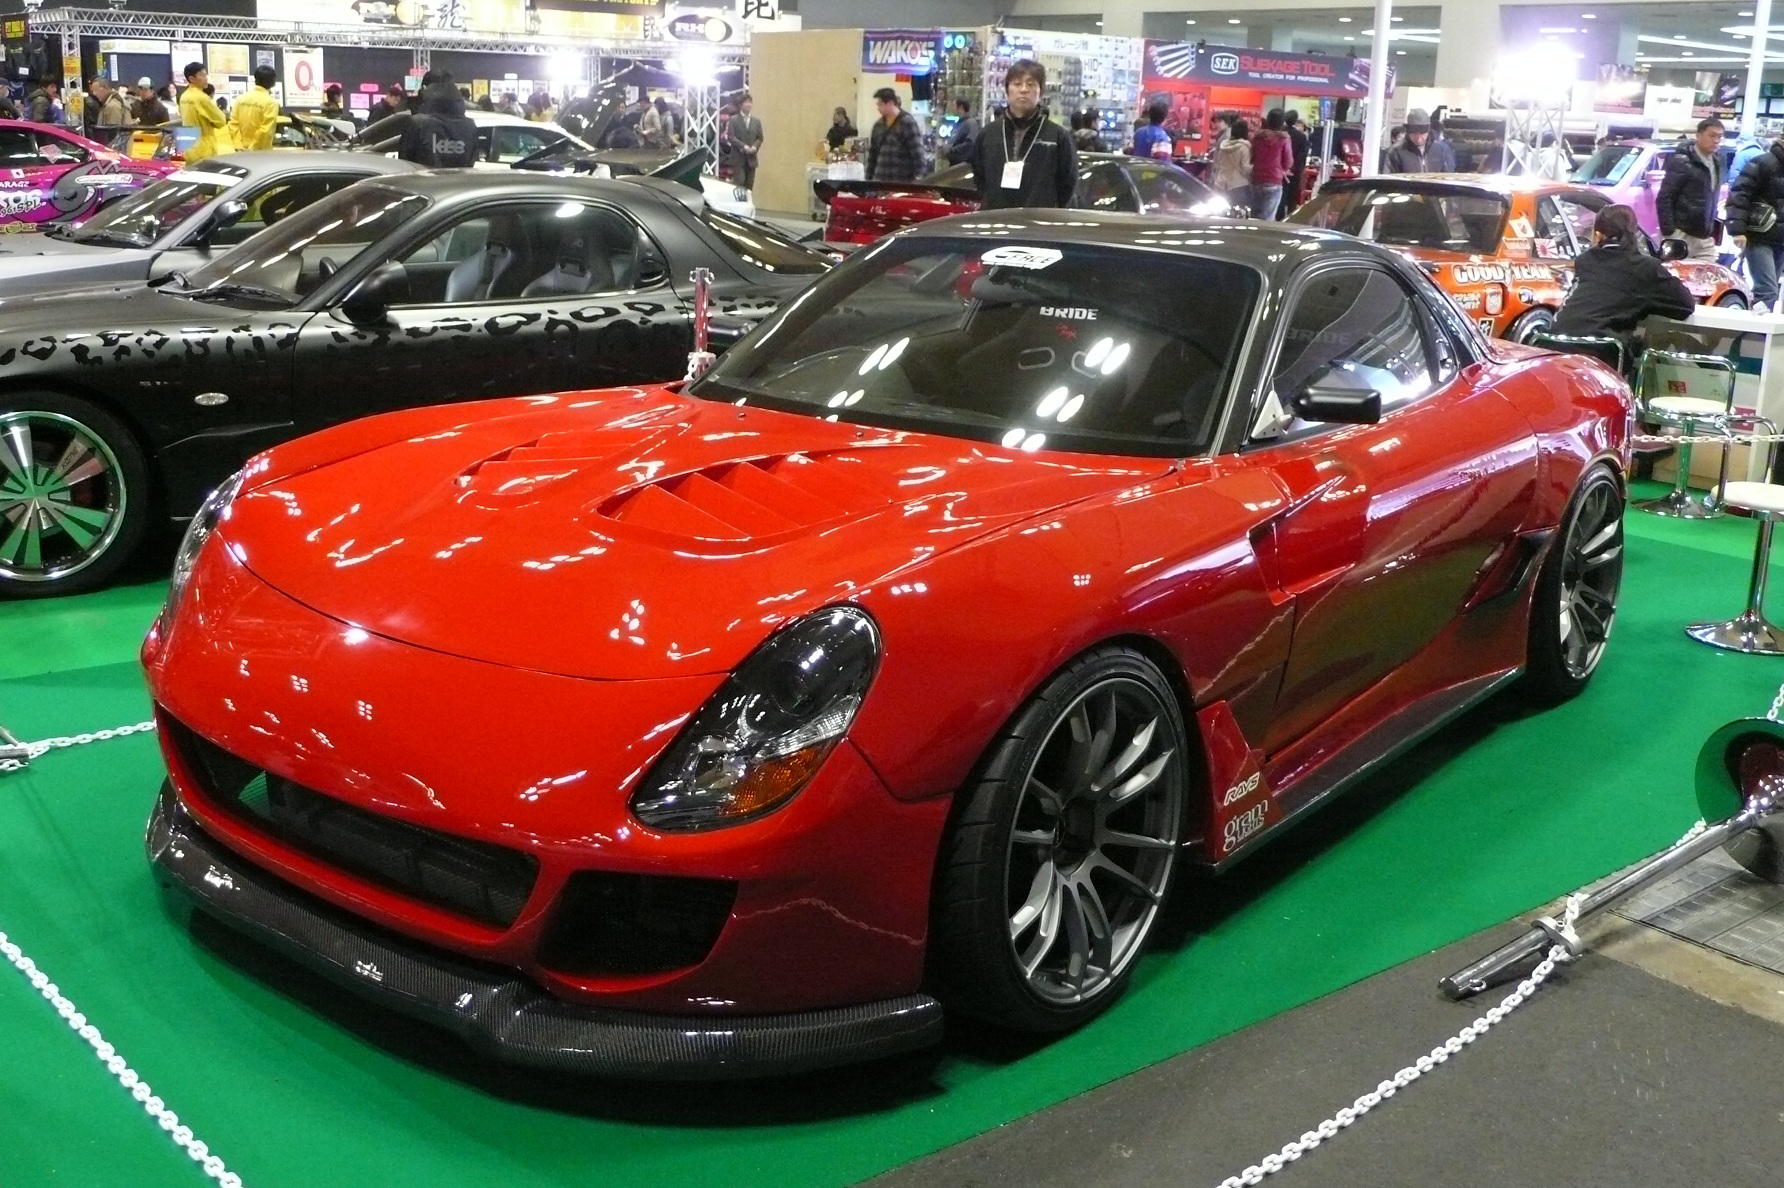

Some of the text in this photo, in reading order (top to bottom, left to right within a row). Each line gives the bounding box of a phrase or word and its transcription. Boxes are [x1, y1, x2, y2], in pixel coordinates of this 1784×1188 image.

[1213, 56, 1238, 70] SEK
[1301, 60, 1336, 77] TOOL
[1039, 306, 1099, 320] BRIDE
[1223, 771, 1260, 806] RAYS
